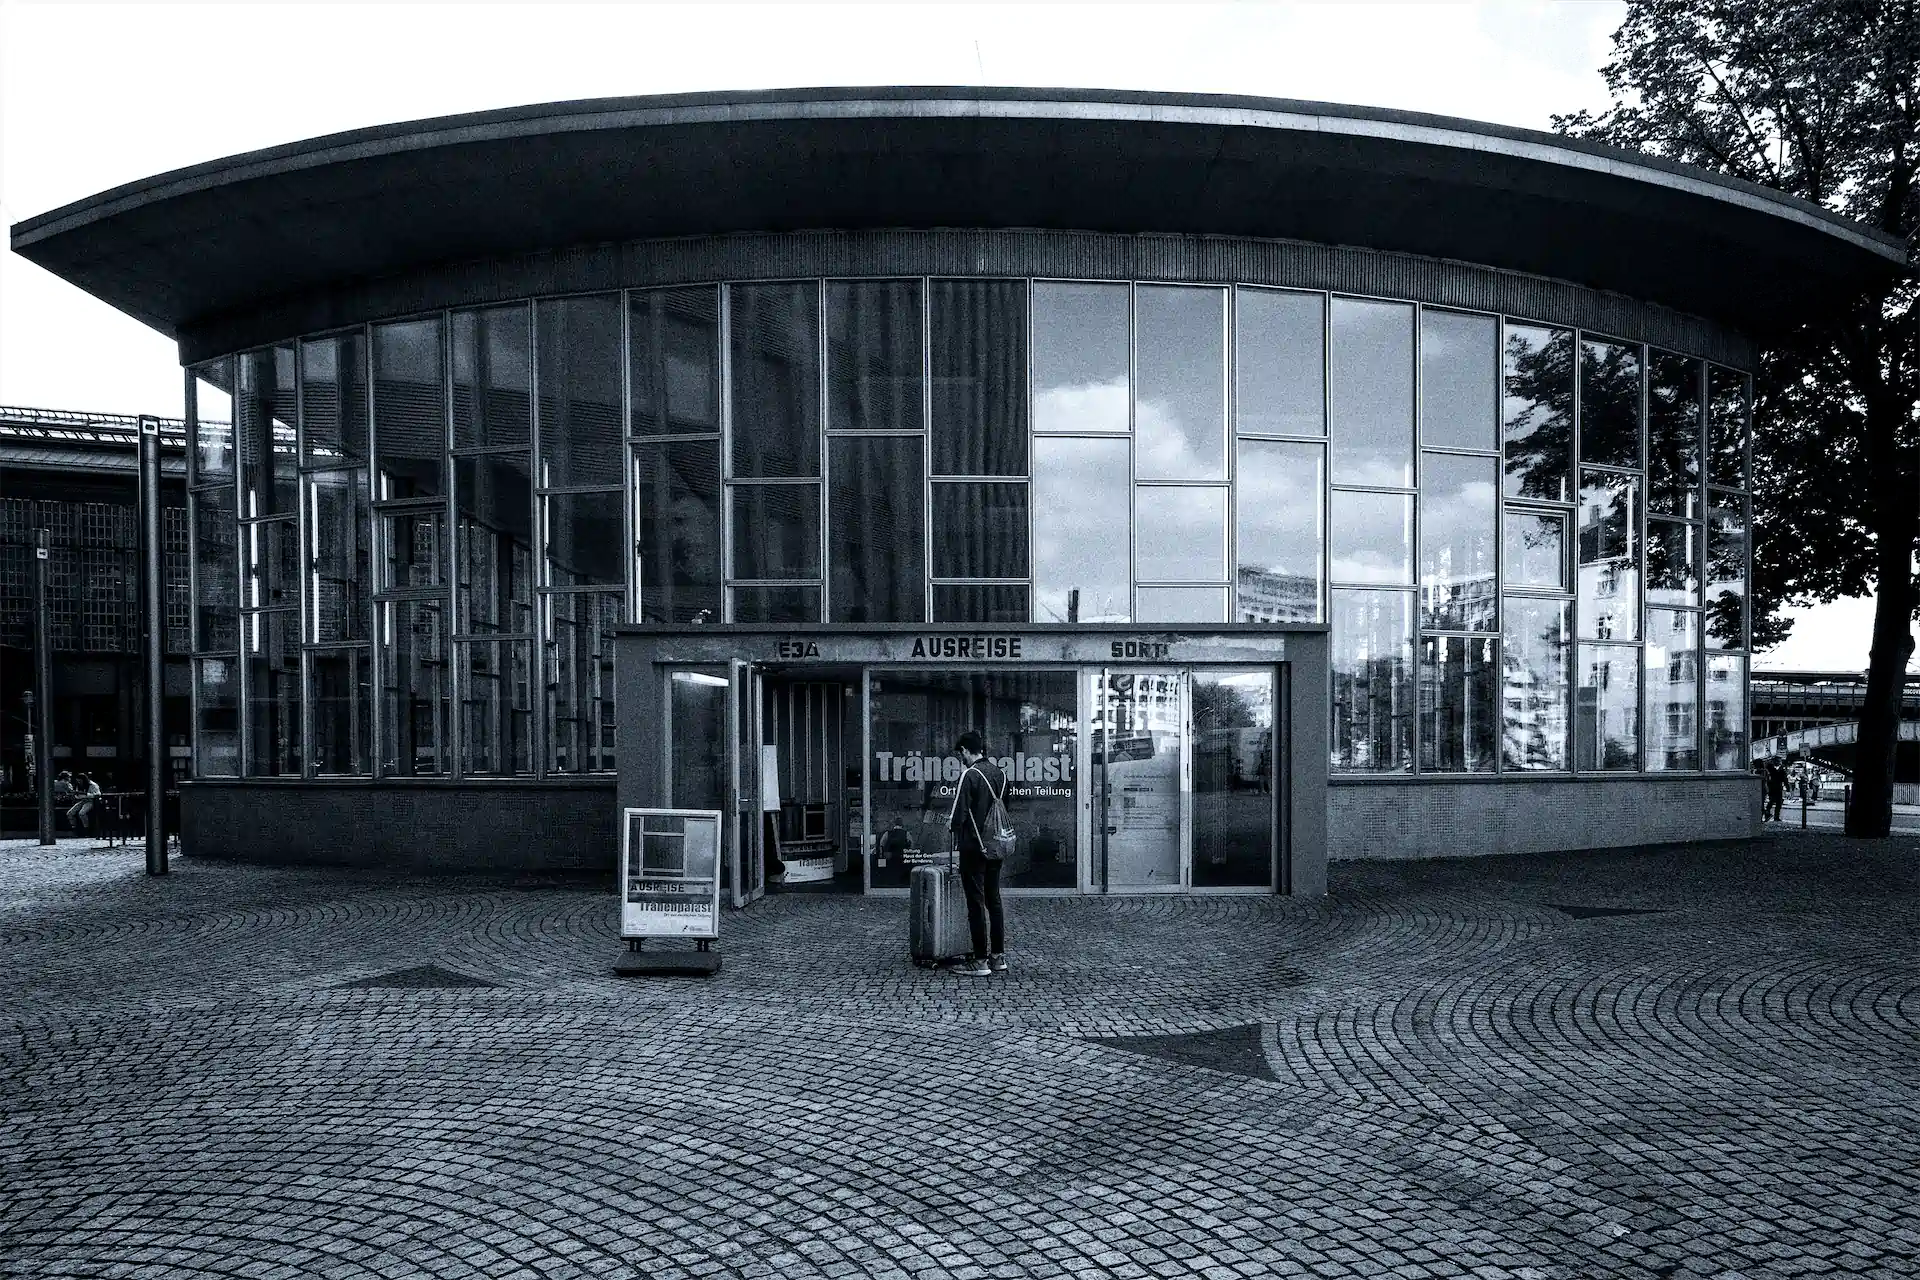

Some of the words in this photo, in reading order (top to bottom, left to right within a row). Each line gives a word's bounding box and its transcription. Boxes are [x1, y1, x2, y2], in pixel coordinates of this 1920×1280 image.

[911, 637, 1021, 658] AUSREISE
[875, 751, 1071, 782] Tränealast
[939, 785, 957, 796] Ort
[1034, 785, 1072, 798] Teilung
[630, 882, 685, 893] AUSREISE
